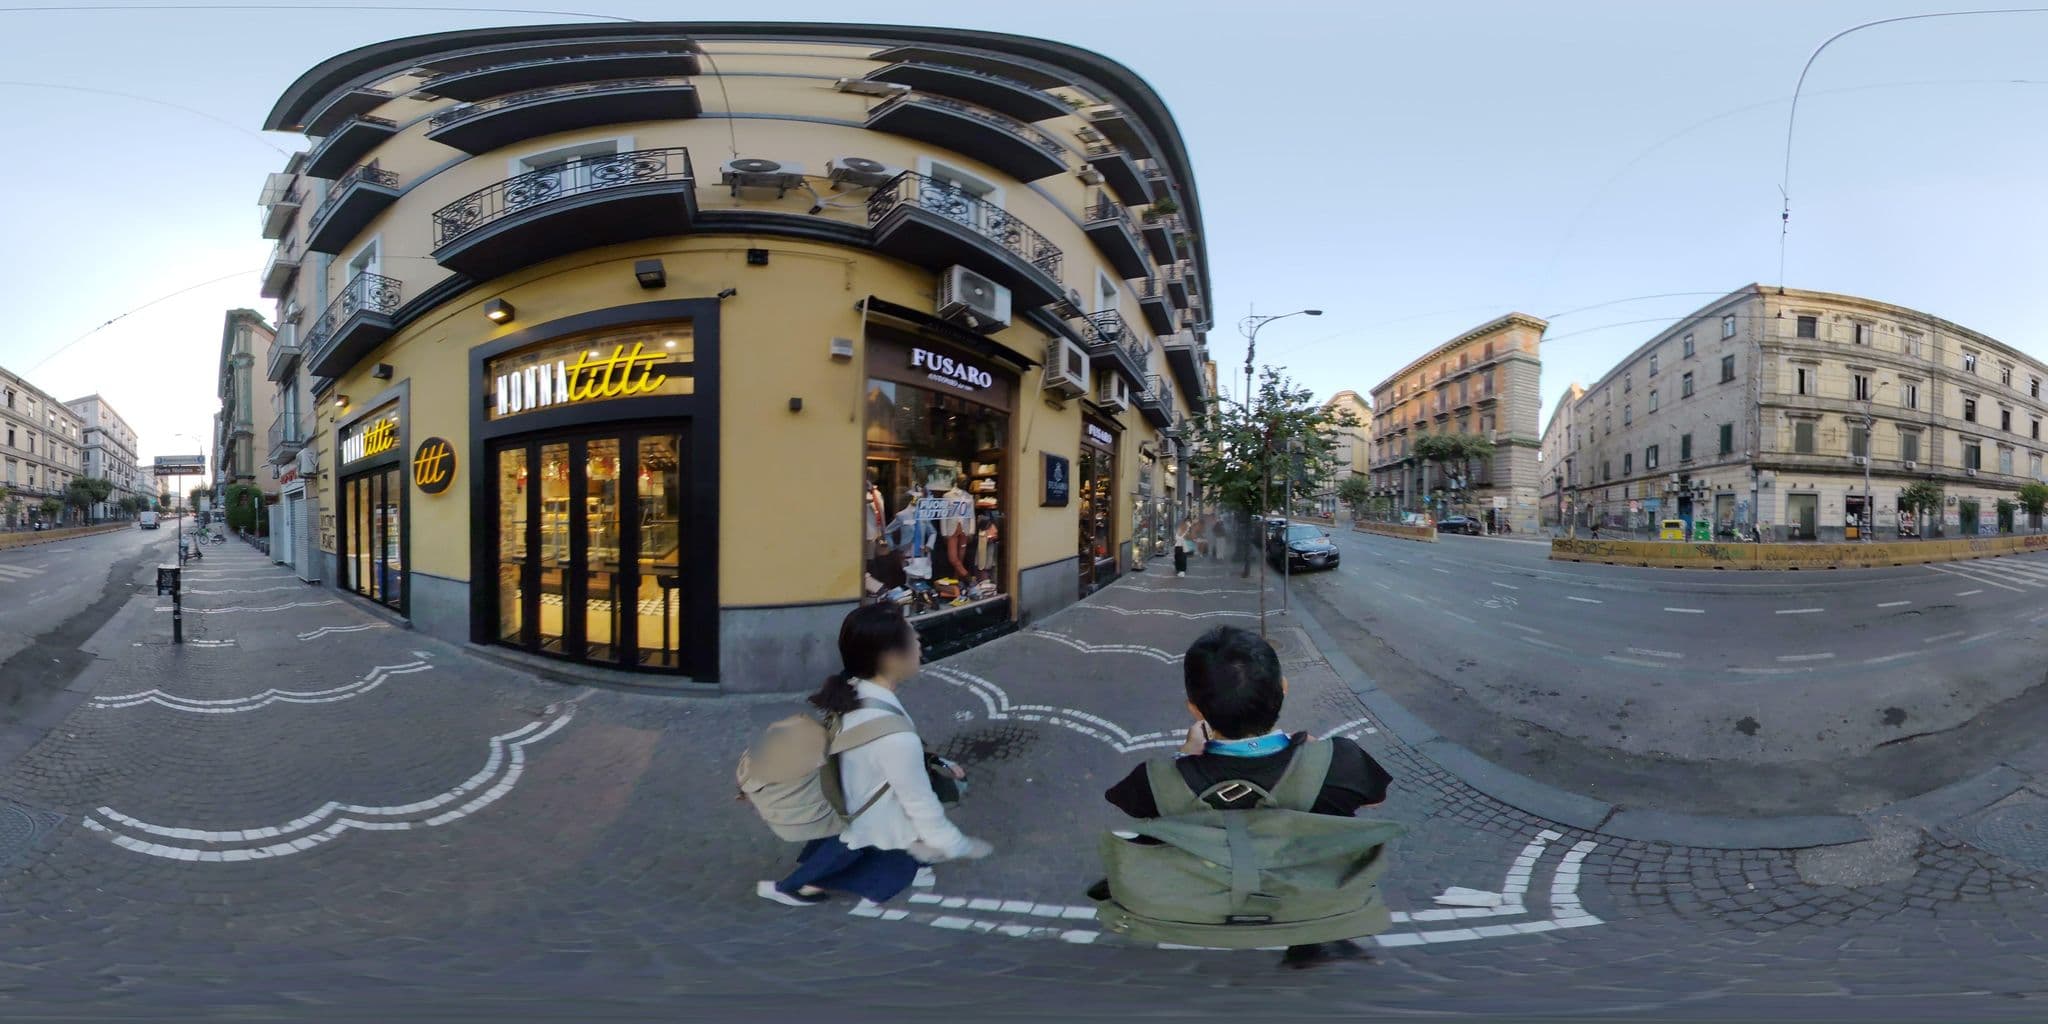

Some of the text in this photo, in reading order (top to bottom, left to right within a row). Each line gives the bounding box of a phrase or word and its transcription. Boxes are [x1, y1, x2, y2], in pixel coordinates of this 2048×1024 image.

[497, 341, 668, 416] NONNA titti
[911, 347, 993, 388] FUSARO
[343, 418, 395, 464] NONNA titti
[1089, 424, 1113, 444] FUSARO
